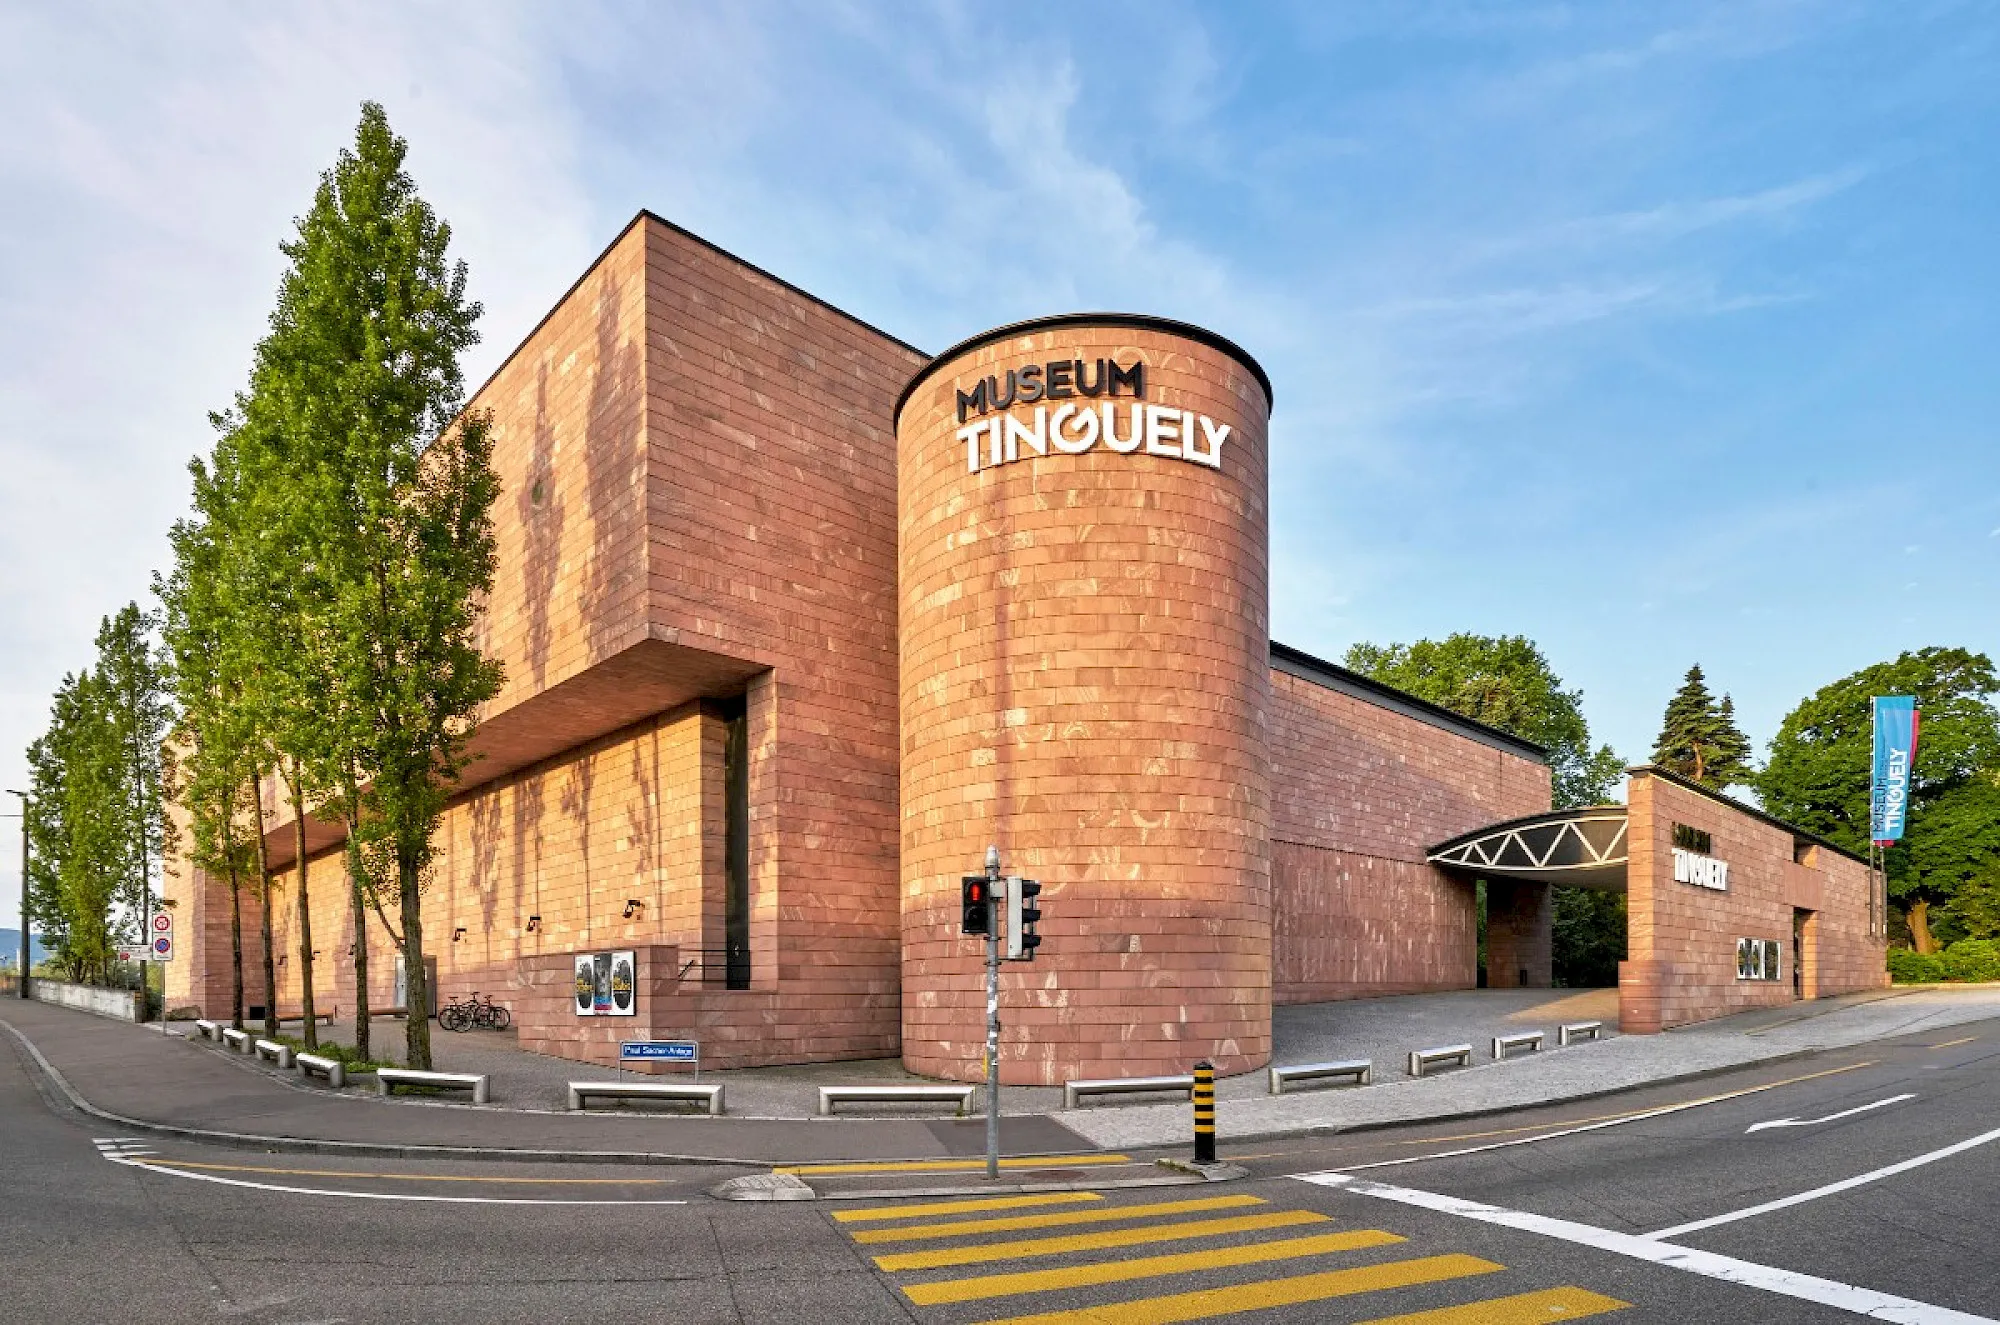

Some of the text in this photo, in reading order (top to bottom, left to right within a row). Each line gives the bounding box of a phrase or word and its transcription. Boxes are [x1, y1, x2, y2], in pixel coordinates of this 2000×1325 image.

[956, 357, 1144, 424] MUSEUM
[956, 401, 1232, 474] TINGUELY
[1873, 777, 1887, 833] MUSEUM
[1885, 747, 1908, 833] TINGUELY
